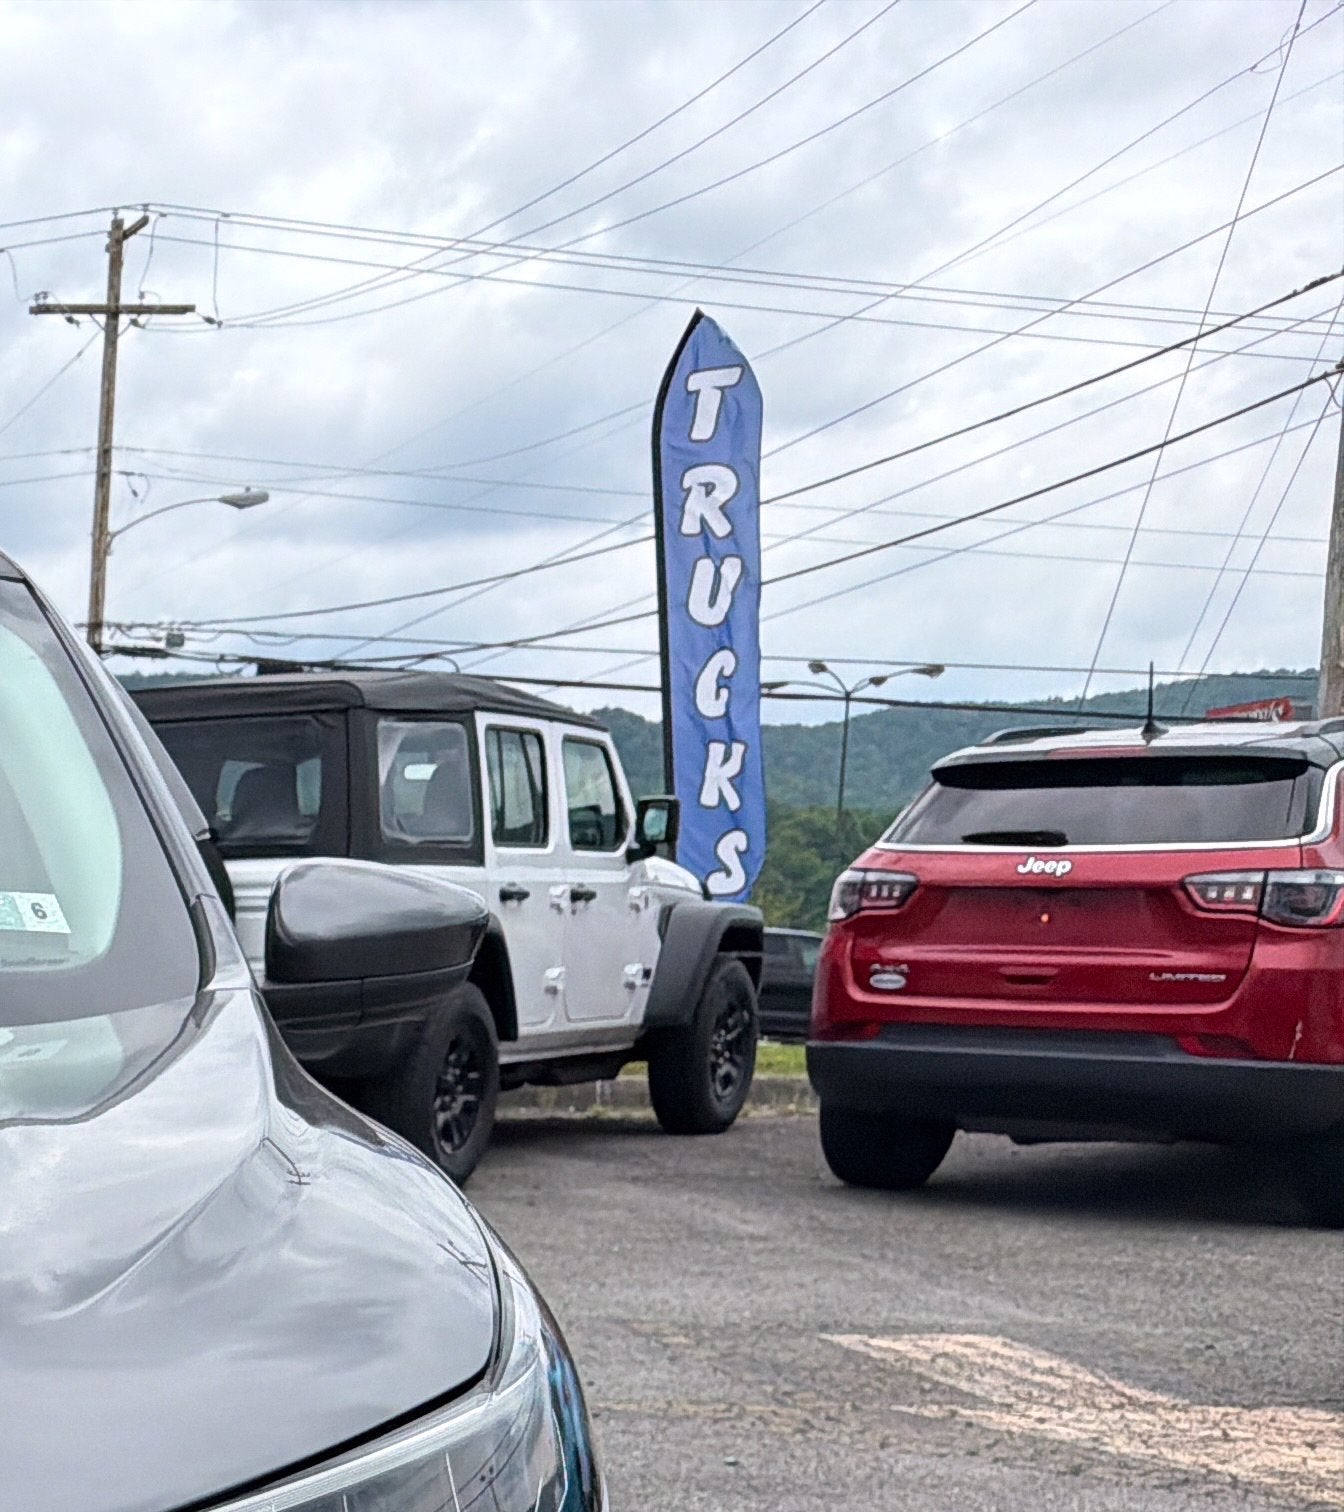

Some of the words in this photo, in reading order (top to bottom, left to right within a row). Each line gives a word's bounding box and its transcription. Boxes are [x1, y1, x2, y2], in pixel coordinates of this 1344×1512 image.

[679, 365, 749, 896] TRUCKS
[1017, 856, 1072, 877] Jeep
[30, 902, 48, 920] 6
